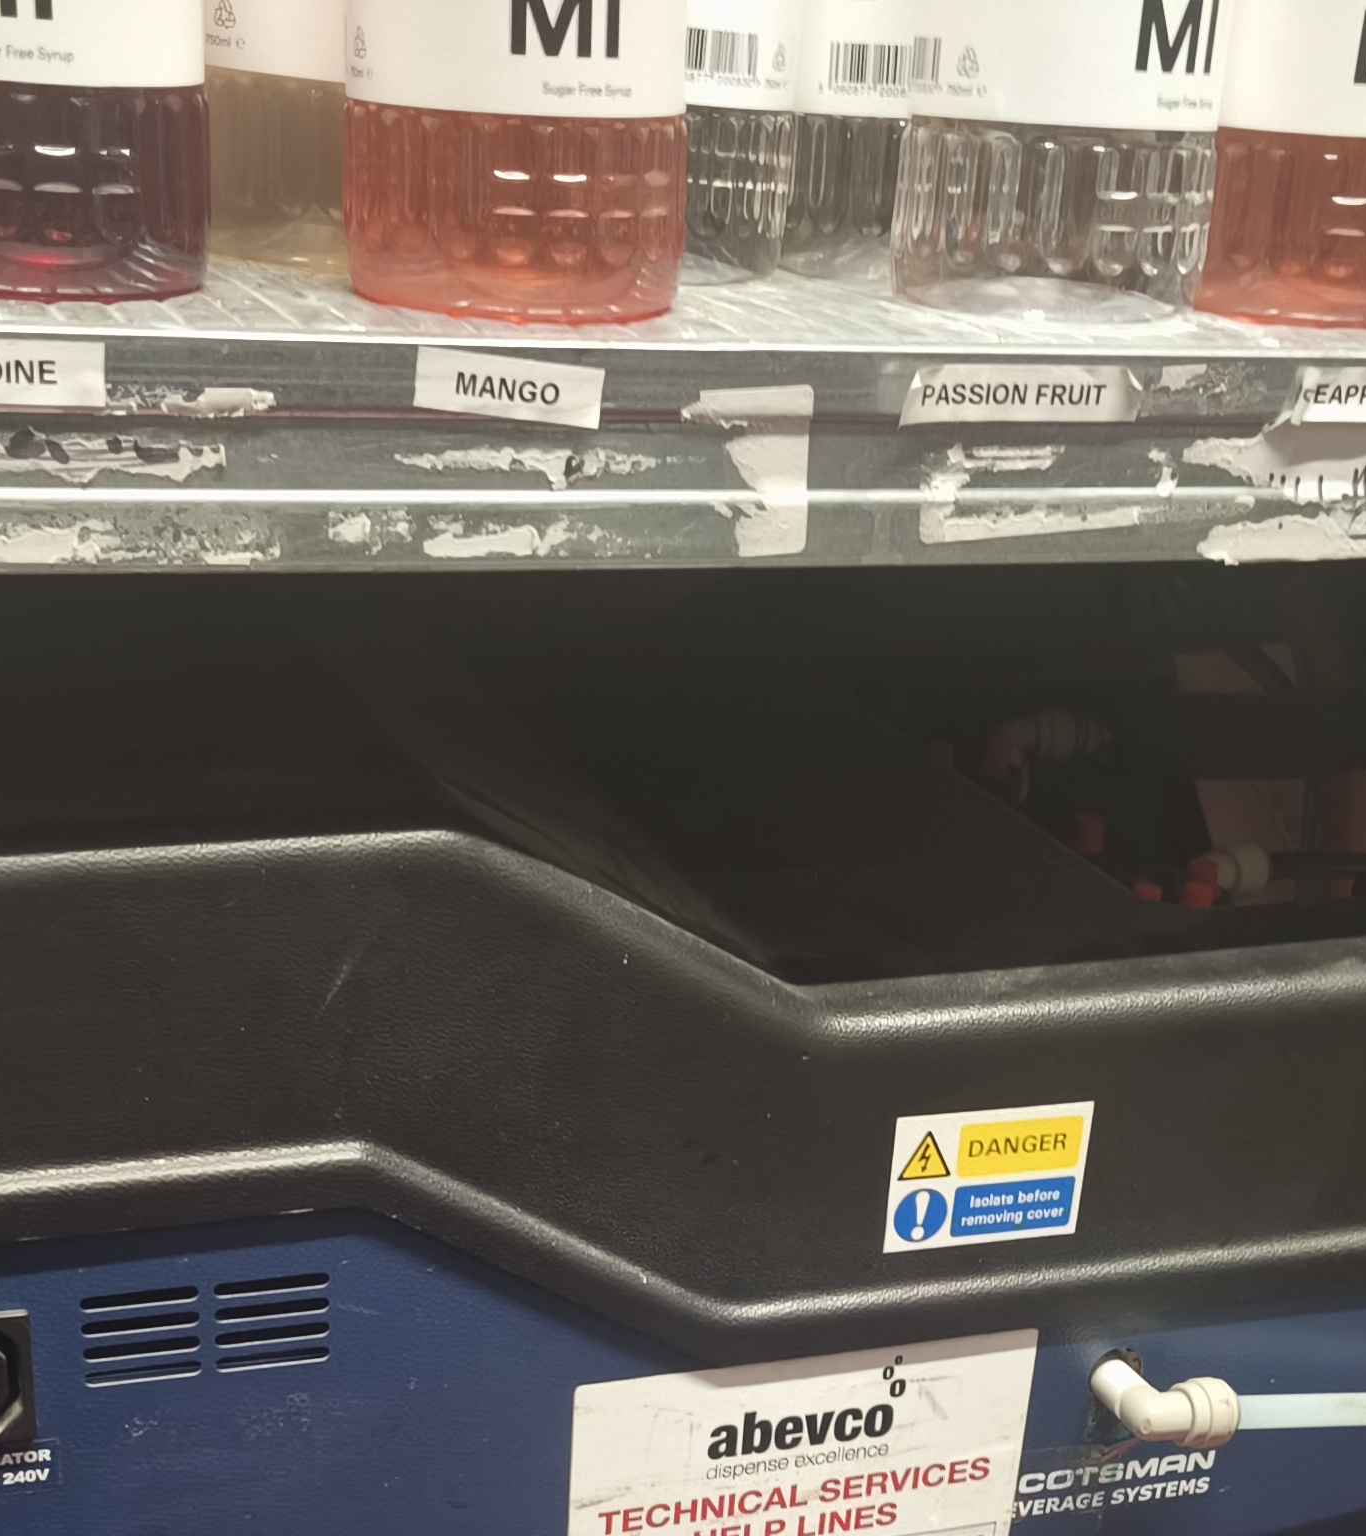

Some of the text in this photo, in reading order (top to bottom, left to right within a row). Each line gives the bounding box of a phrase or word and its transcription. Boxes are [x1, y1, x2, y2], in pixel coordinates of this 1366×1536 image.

[455, 371, 560, 405] MANGO
[921, 383, 1108, 407] PASSION FRUIT
[968, 1132, 1068, 1158] DANGER
[961, 1205, 1065, 1227] removing cover
[969, 1189, 1061, 1209] Isolate before
[707, 1403, 895, 1461] abevco
[3, 1469, 51, 1486] 240V
[706, 1442, 890, 1481] dispense excellence
[1018, 1448, 1217, 1495] COTSMAN
[598, 1456, 991, 1536] TECHNICAL SERVICES
[1010, 1477, 1212, 1519] VERAGE SYSTEMS
